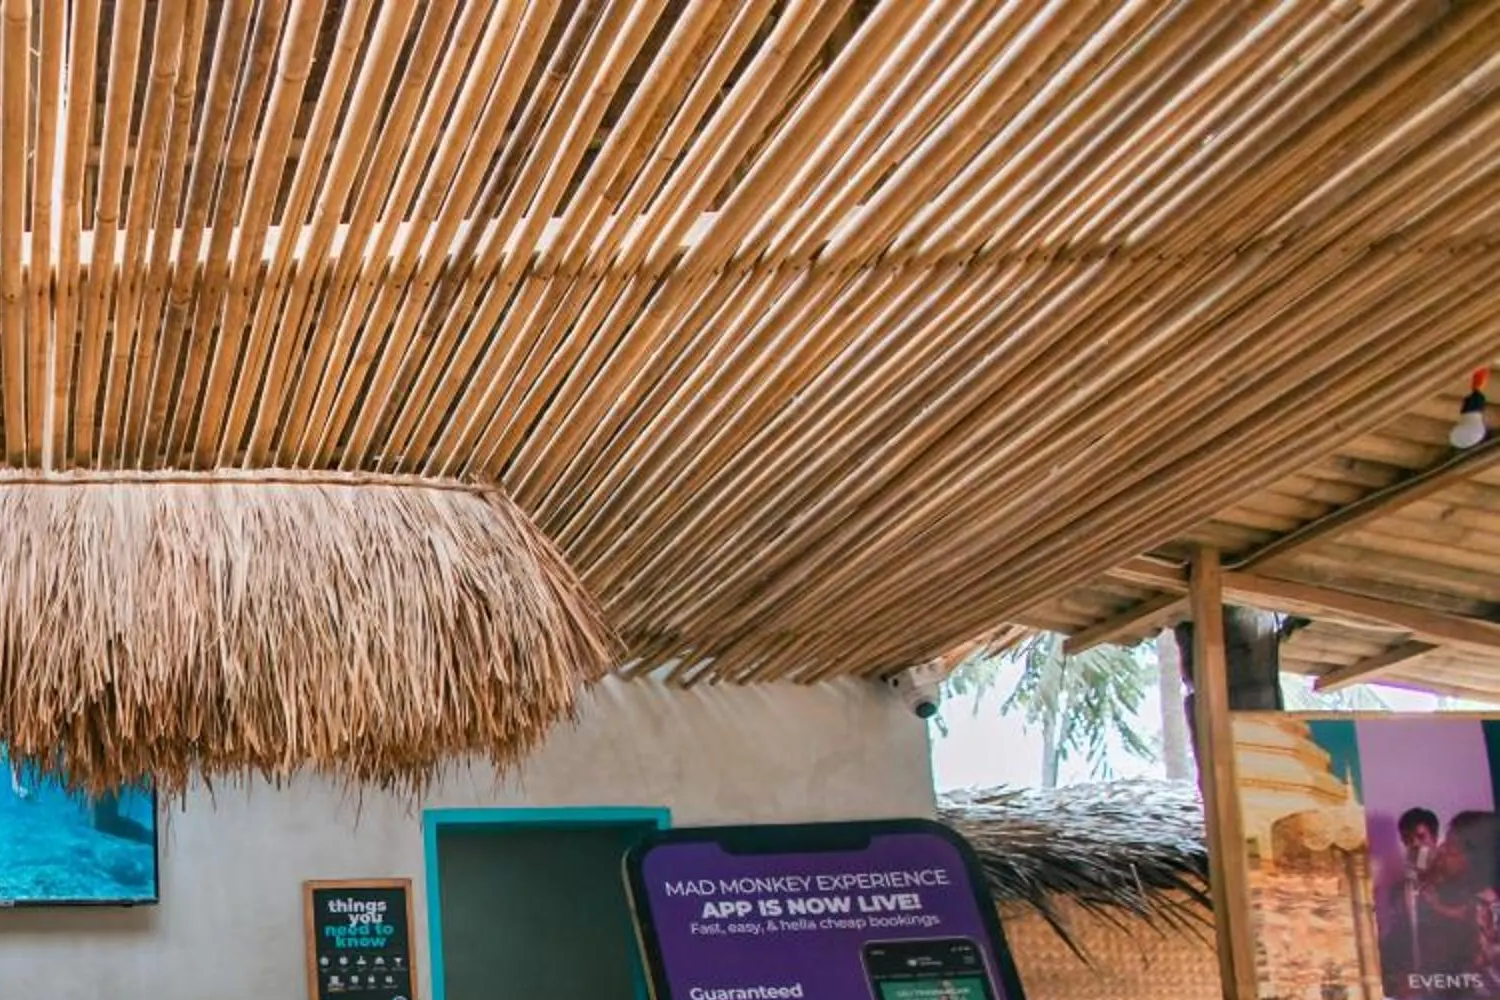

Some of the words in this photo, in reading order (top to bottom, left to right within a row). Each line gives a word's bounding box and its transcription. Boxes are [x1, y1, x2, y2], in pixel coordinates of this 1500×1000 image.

[665, 881, 716, 896] MAD
[720, 875, 811, 894] MONKEY
[817, 869, 950, 890] EXPERIENCE
[328, 898, 387, 914] things
[702, 901, 752, 919] APP
[759, 900, 783, 915] IS
[789, 896, 852, 915] NOW
[858, 893, 923, 912] LIVE!
[348, 912, 383, 928] you
[690, 922, 727, 935] Fast,
[728, 921, 765, 935] easy,
[766, 919, 779, 931] &
[780, 919, 817, 931] hella
[820, 915, 867, 931] cheap
[870, 912, 941, 928] bookings
[324, 925, 370, 937] need
[374, 924, 394, 936] to
[336, 936, 387, 948] know
[1408, 973, 1484, 989] EVENTS
